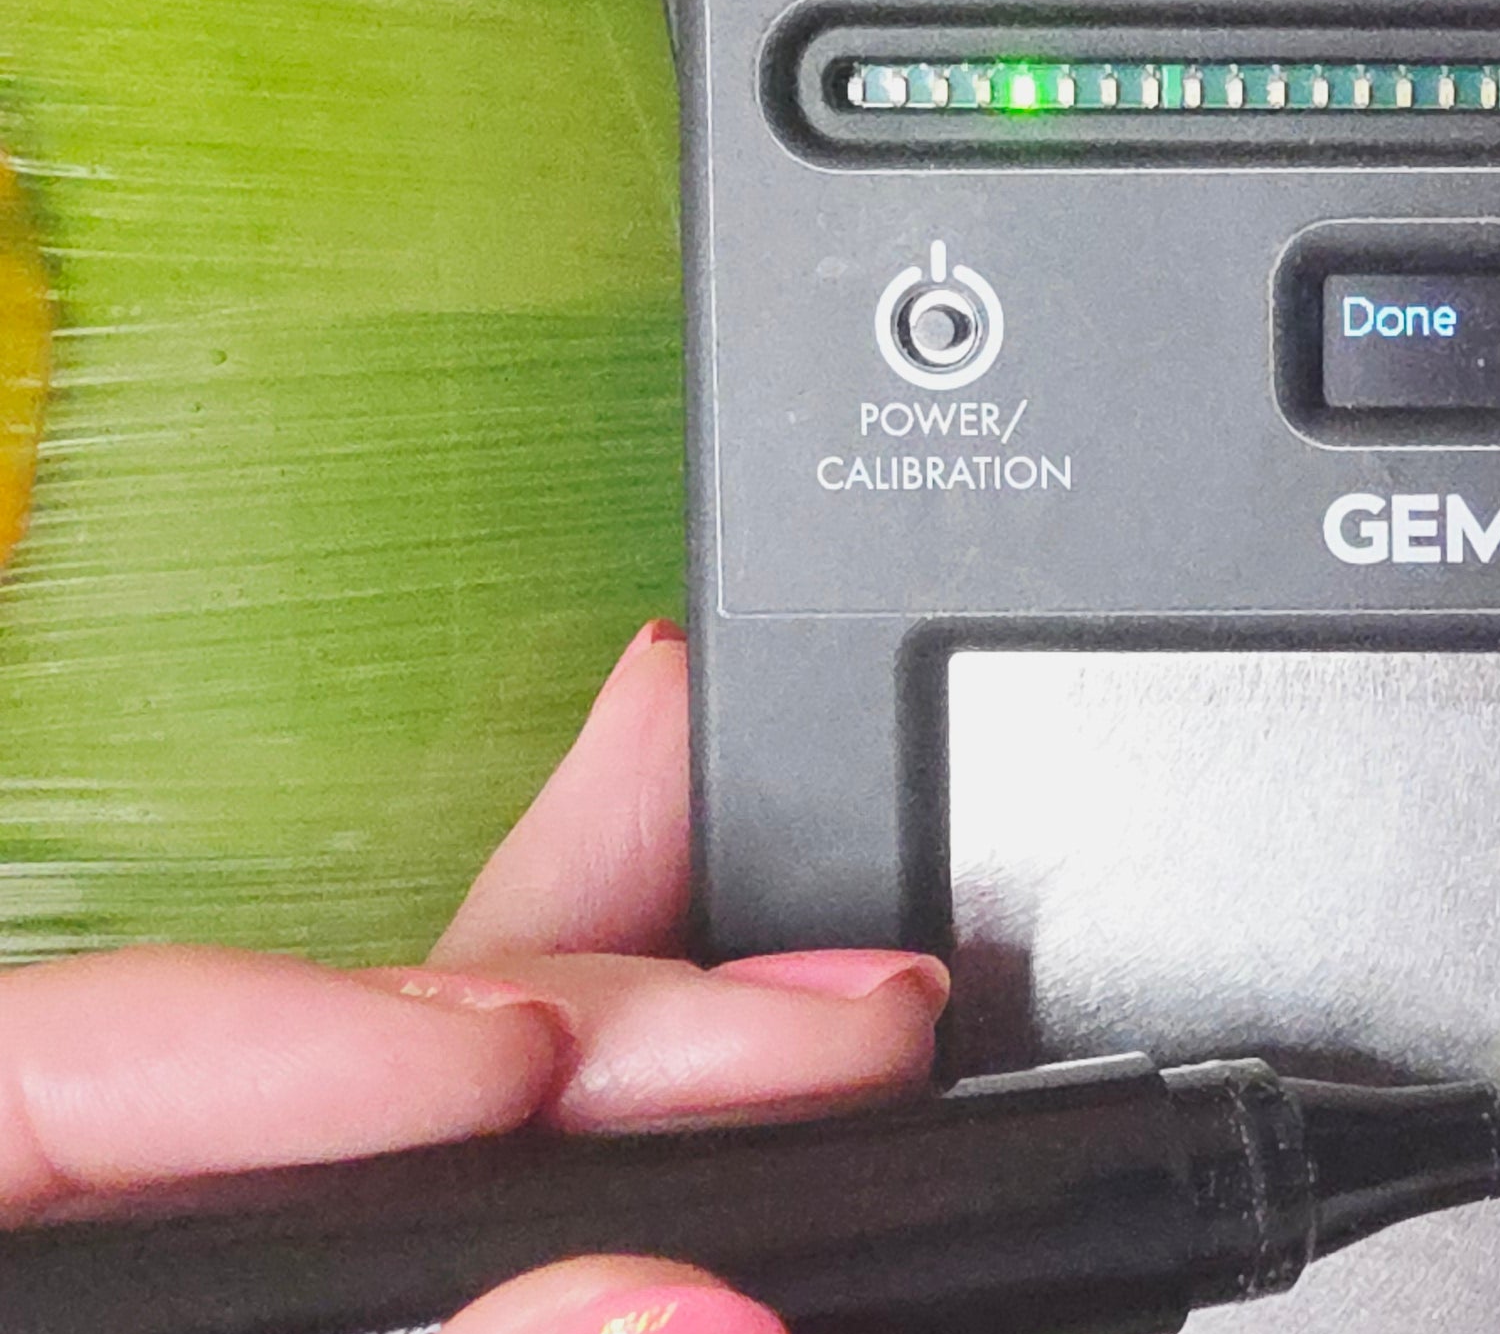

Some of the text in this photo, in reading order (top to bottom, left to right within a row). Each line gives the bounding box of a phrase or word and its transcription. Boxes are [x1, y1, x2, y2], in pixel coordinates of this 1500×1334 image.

[1342, 296, 1457, 337] Done
[860, 399, 1028, 444] POWER/
[816, 455, 1071, 490] CALIBRATION
